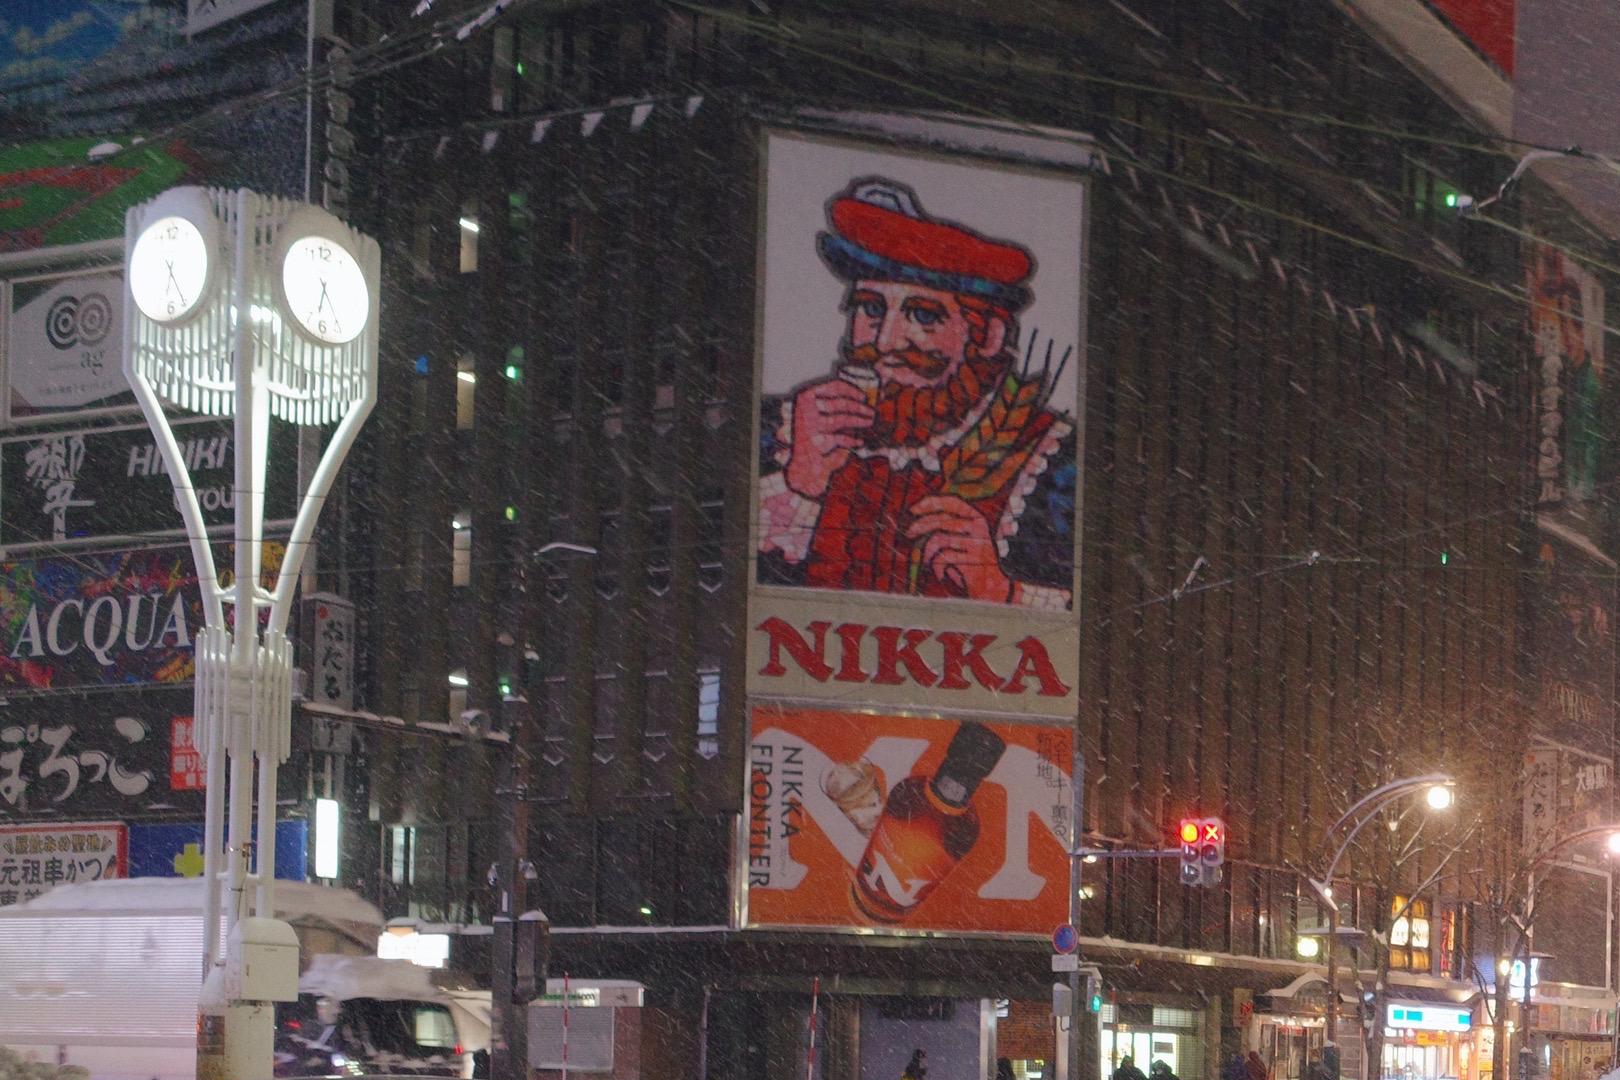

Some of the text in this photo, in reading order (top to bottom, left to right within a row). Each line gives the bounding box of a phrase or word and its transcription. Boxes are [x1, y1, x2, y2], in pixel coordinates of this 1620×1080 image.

[10, 591, 193, 666] ACQUA
[755, 616, 1073, 697] NIKKA
[750, 743, 774, 889] FRONTIER
[780, 745, 804, 840] NIKKA
